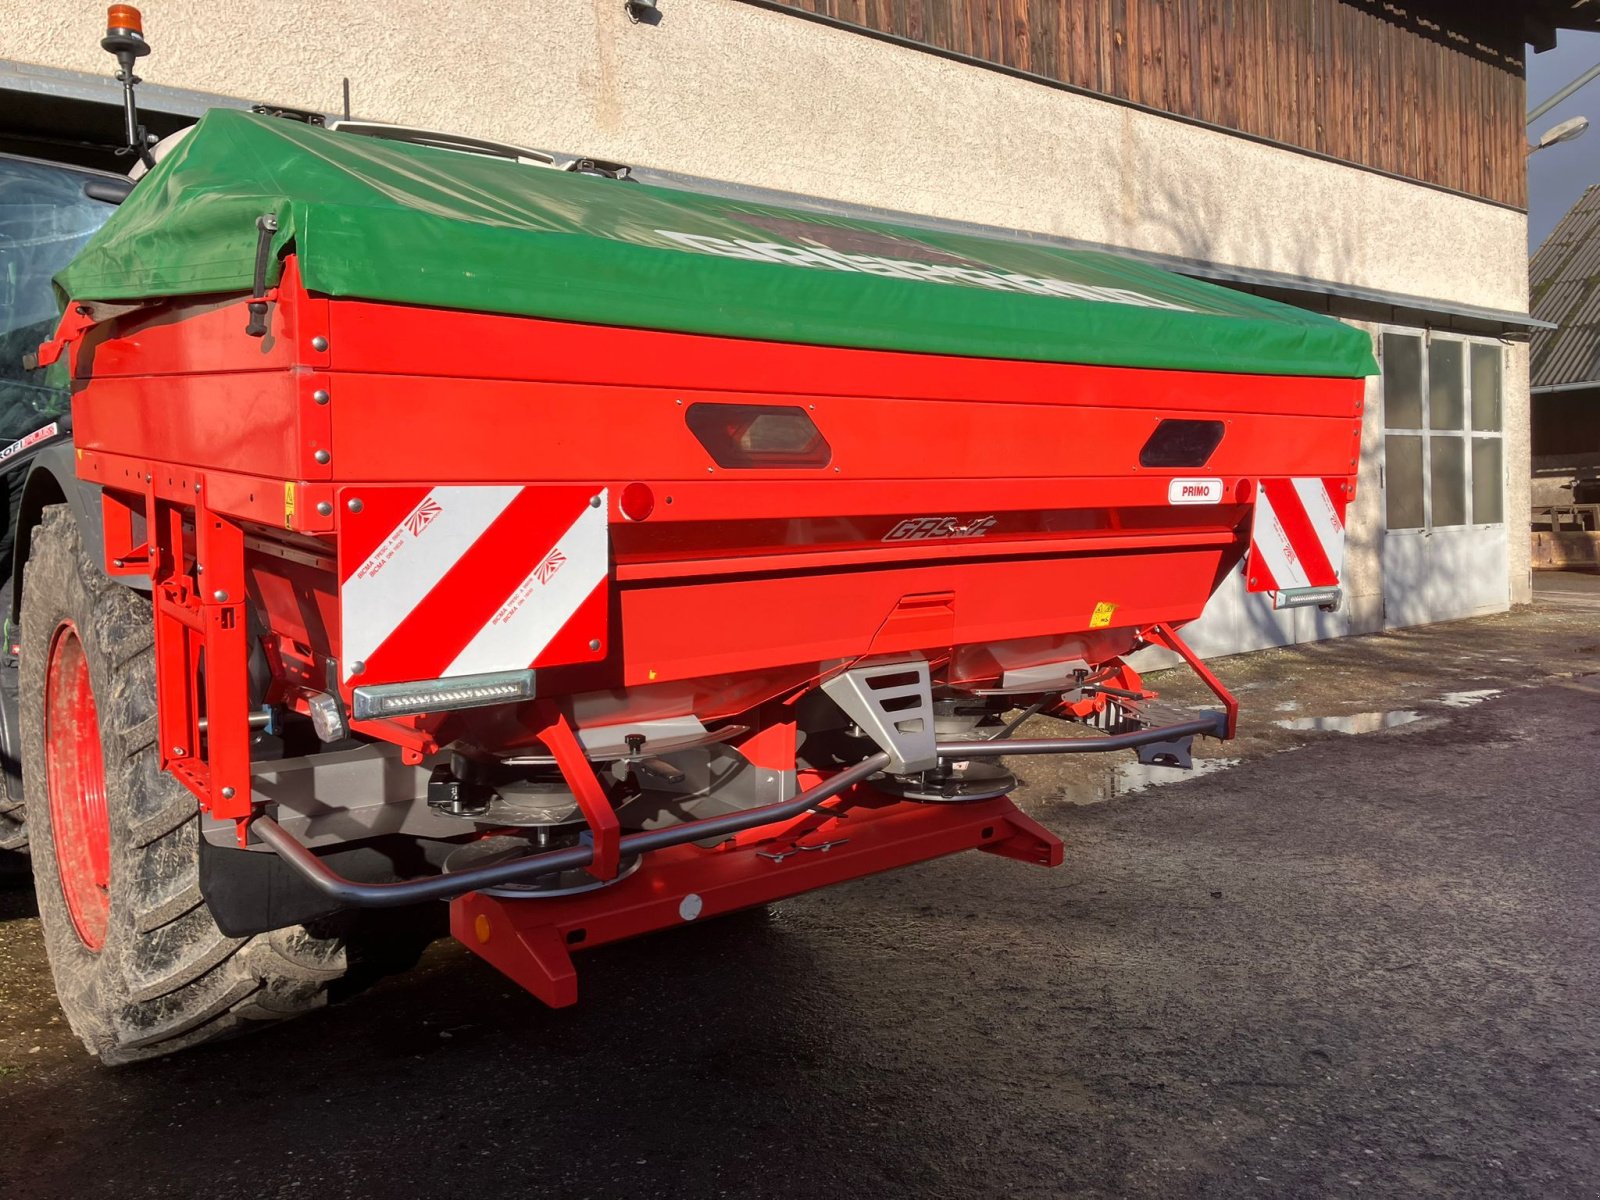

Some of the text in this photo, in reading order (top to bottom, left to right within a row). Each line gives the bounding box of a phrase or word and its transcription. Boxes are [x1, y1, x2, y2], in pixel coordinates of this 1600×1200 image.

[1182, 486, 1210, 497] PRIMO
[357, 561, 374, 579] BICMA
[369, 559, 386, 577] BICMA
